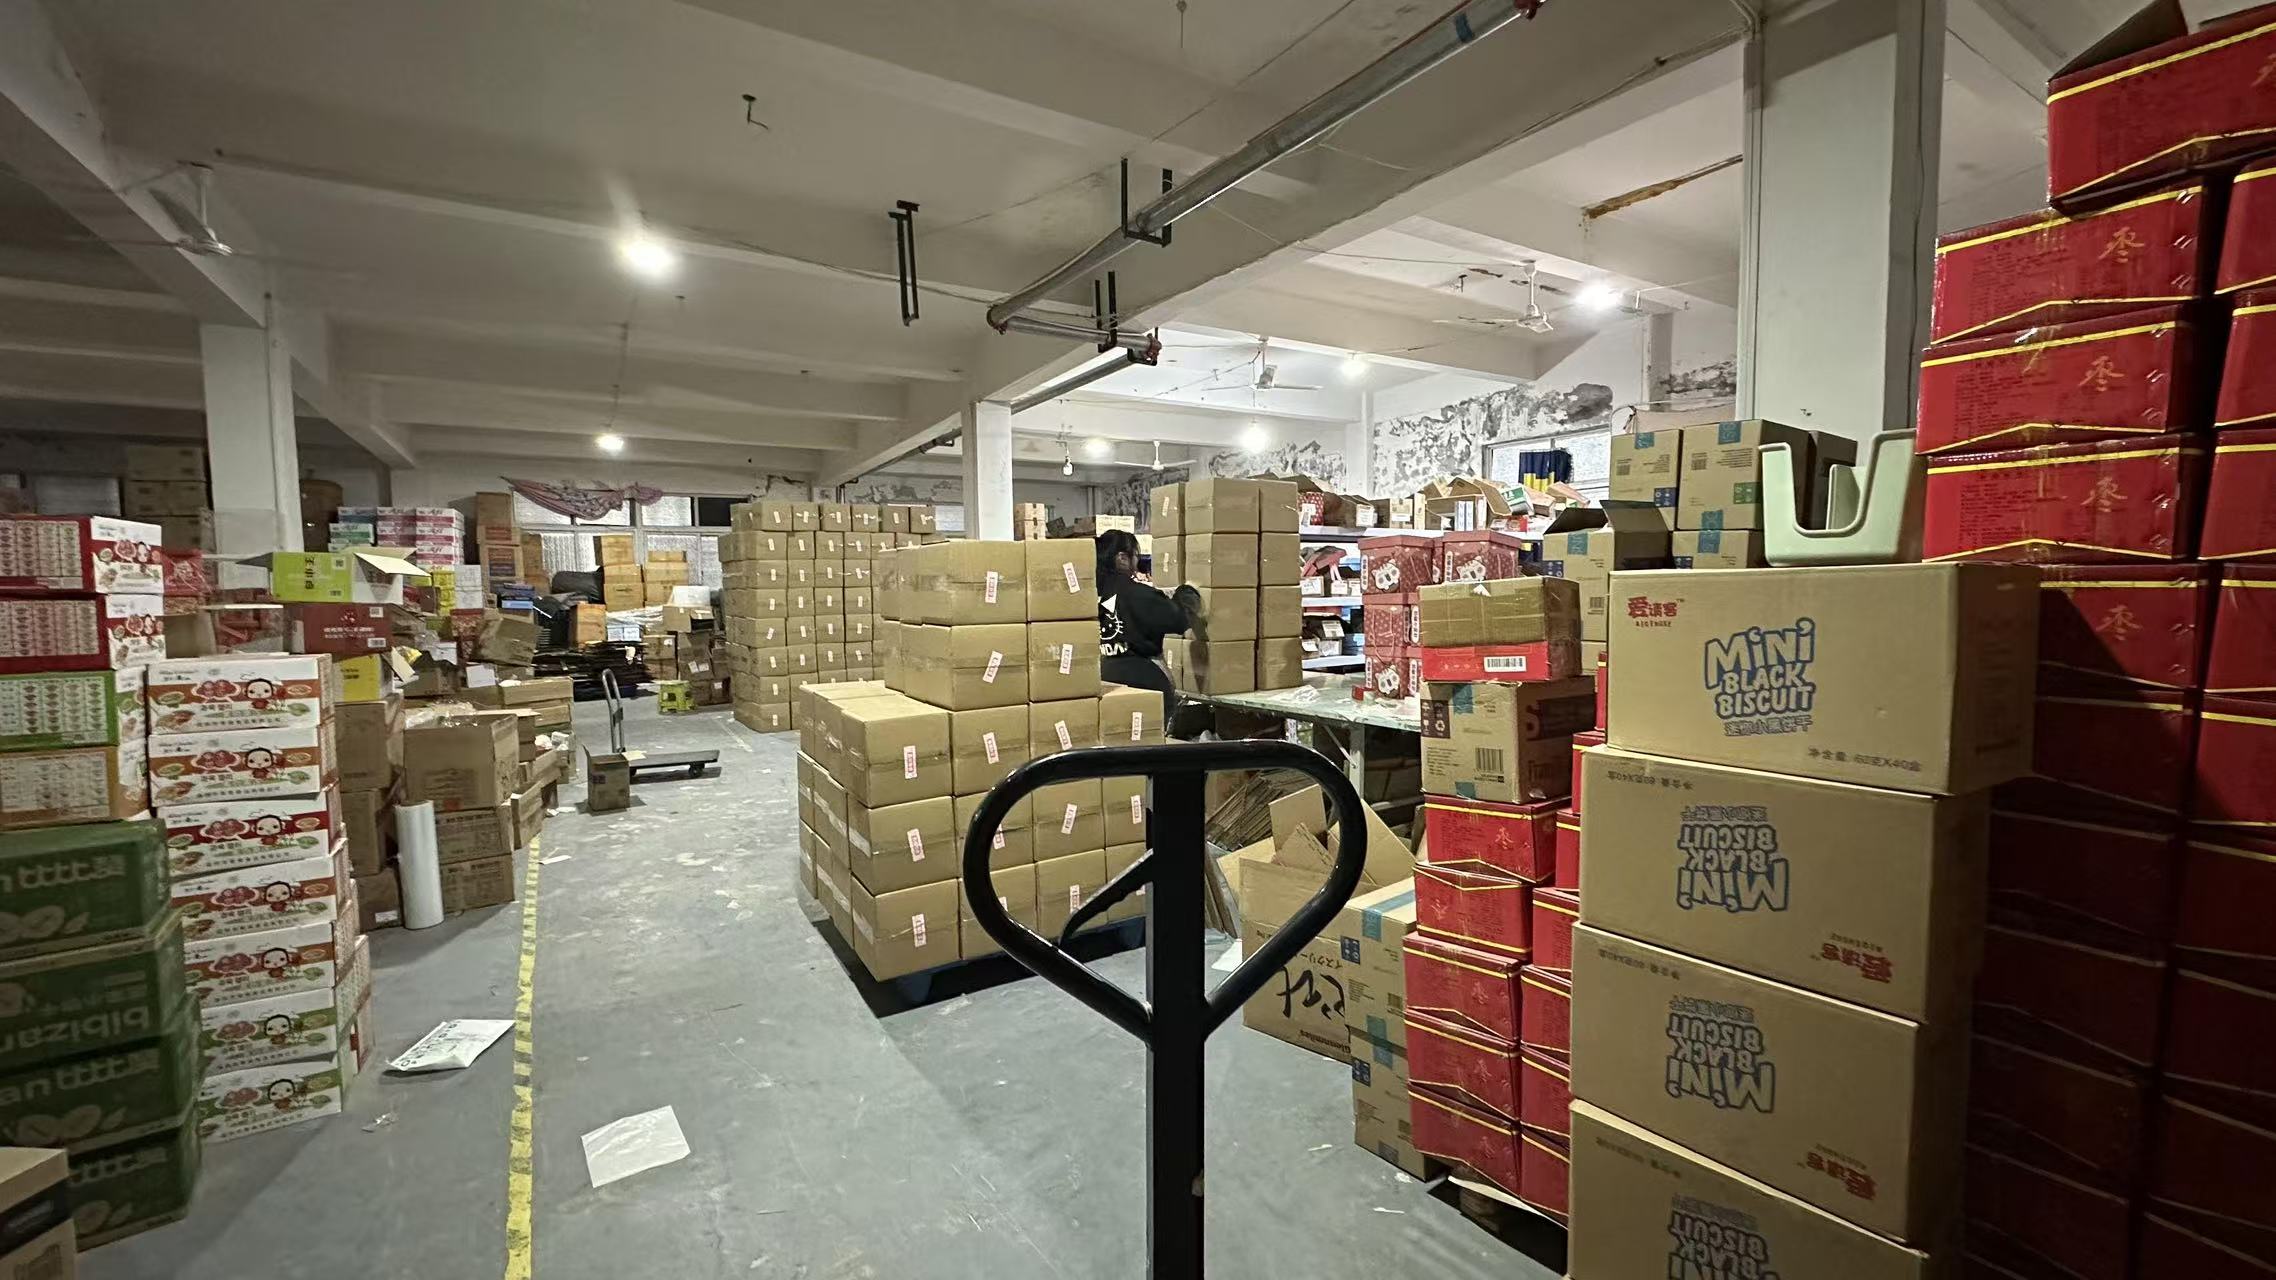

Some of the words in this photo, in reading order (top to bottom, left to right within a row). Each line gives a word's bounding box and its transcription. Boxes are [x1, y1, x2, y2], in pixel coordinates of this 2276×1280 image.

[1721, 663, 1809, 694] BLACK
[1715, 682, 1816, 719] BISCUIT
[1676, 824, 1777, 854] BISCUIT
[1686, 847, 1768, 873] BLACK
[1666, 1013, 1764, 1054] BISCUIT
[1674, 1036, 1756, 1074] BLACK
[1668, 1210, 1767, 1258] BISCUIT
